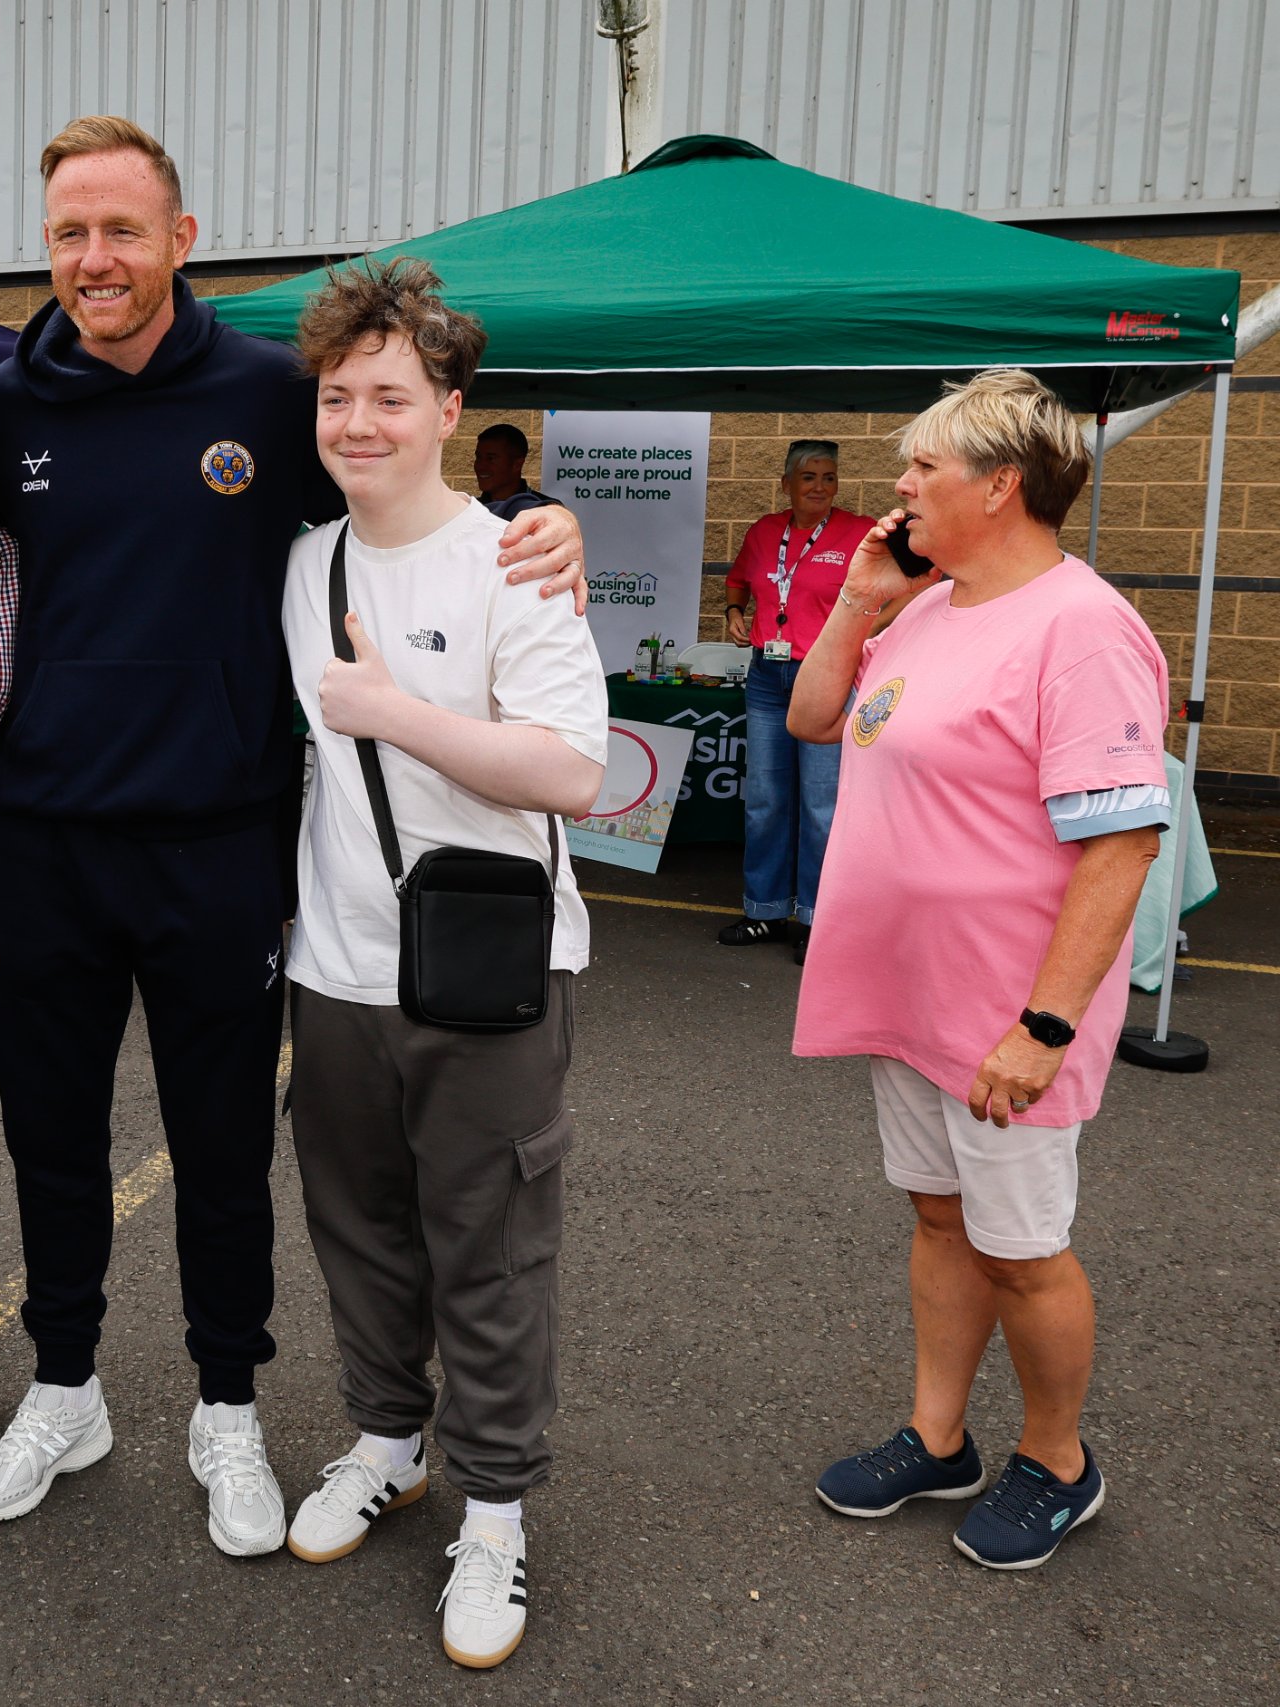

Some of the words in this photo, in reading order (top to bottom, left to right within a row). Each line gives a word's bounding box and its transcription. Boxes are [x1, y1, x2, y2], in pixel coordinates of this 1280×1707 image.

[1127, 326, 1180, 340] Canopy
[558, 446, 584, 459] We
[588, 446, 637, 460] create
[641, 446, 692, 462] places
[556, 466, 610, 481] people
[614, 468, 639, 480] are
[643, 467, 692, 482] proud
[574, 487, 591, 499] to
[595, 486, 621, 499] call
[625, 486, 671, 500] home
[585, 577, 636, 593] ousing
[609, 592, 656, 607] Group
[405, 633, 433, 644] NORTH
[419, 628, 433, 637] THE
[410, 640, 431, 651] FACE
